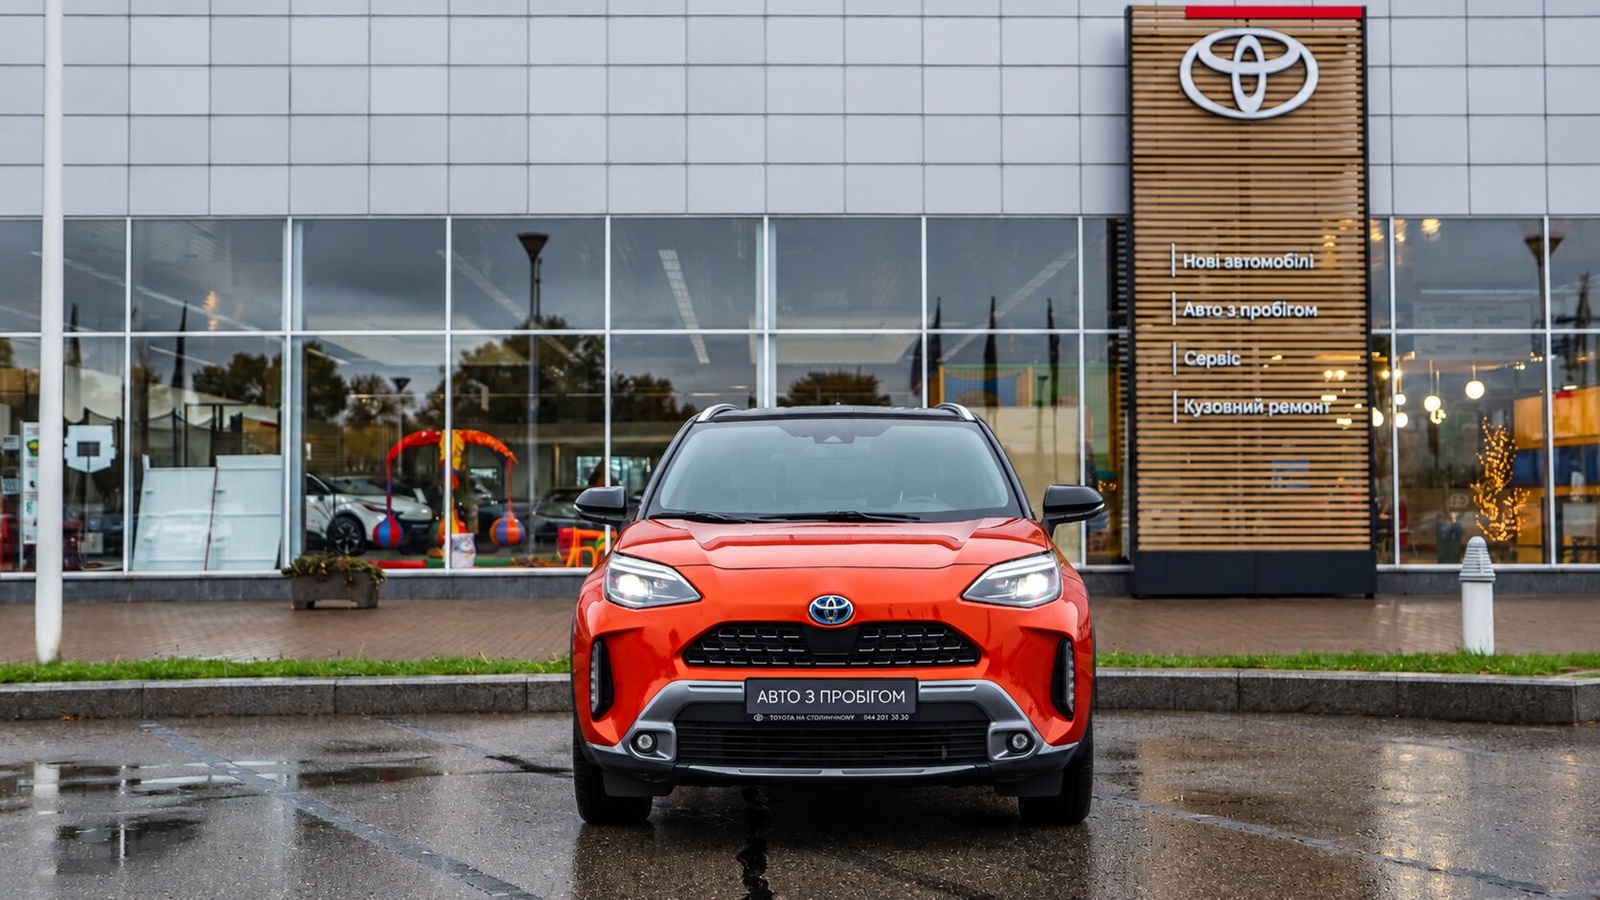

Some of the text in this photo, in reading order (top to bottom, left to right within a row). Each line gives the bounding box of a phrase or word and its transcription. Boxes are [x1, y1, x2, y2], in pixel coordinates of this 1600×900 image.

[1183, 253, 1315, 269] Нові автомобілі
[1183, 301, 1318, 320] Авто з пробігом
[1184, 350, 1241, 369] Сервіс
[1184, 398, 1332, 417] Кузовний ремонт
[757, 690, 906, 704] АВТО З ПРОБІГОМ
